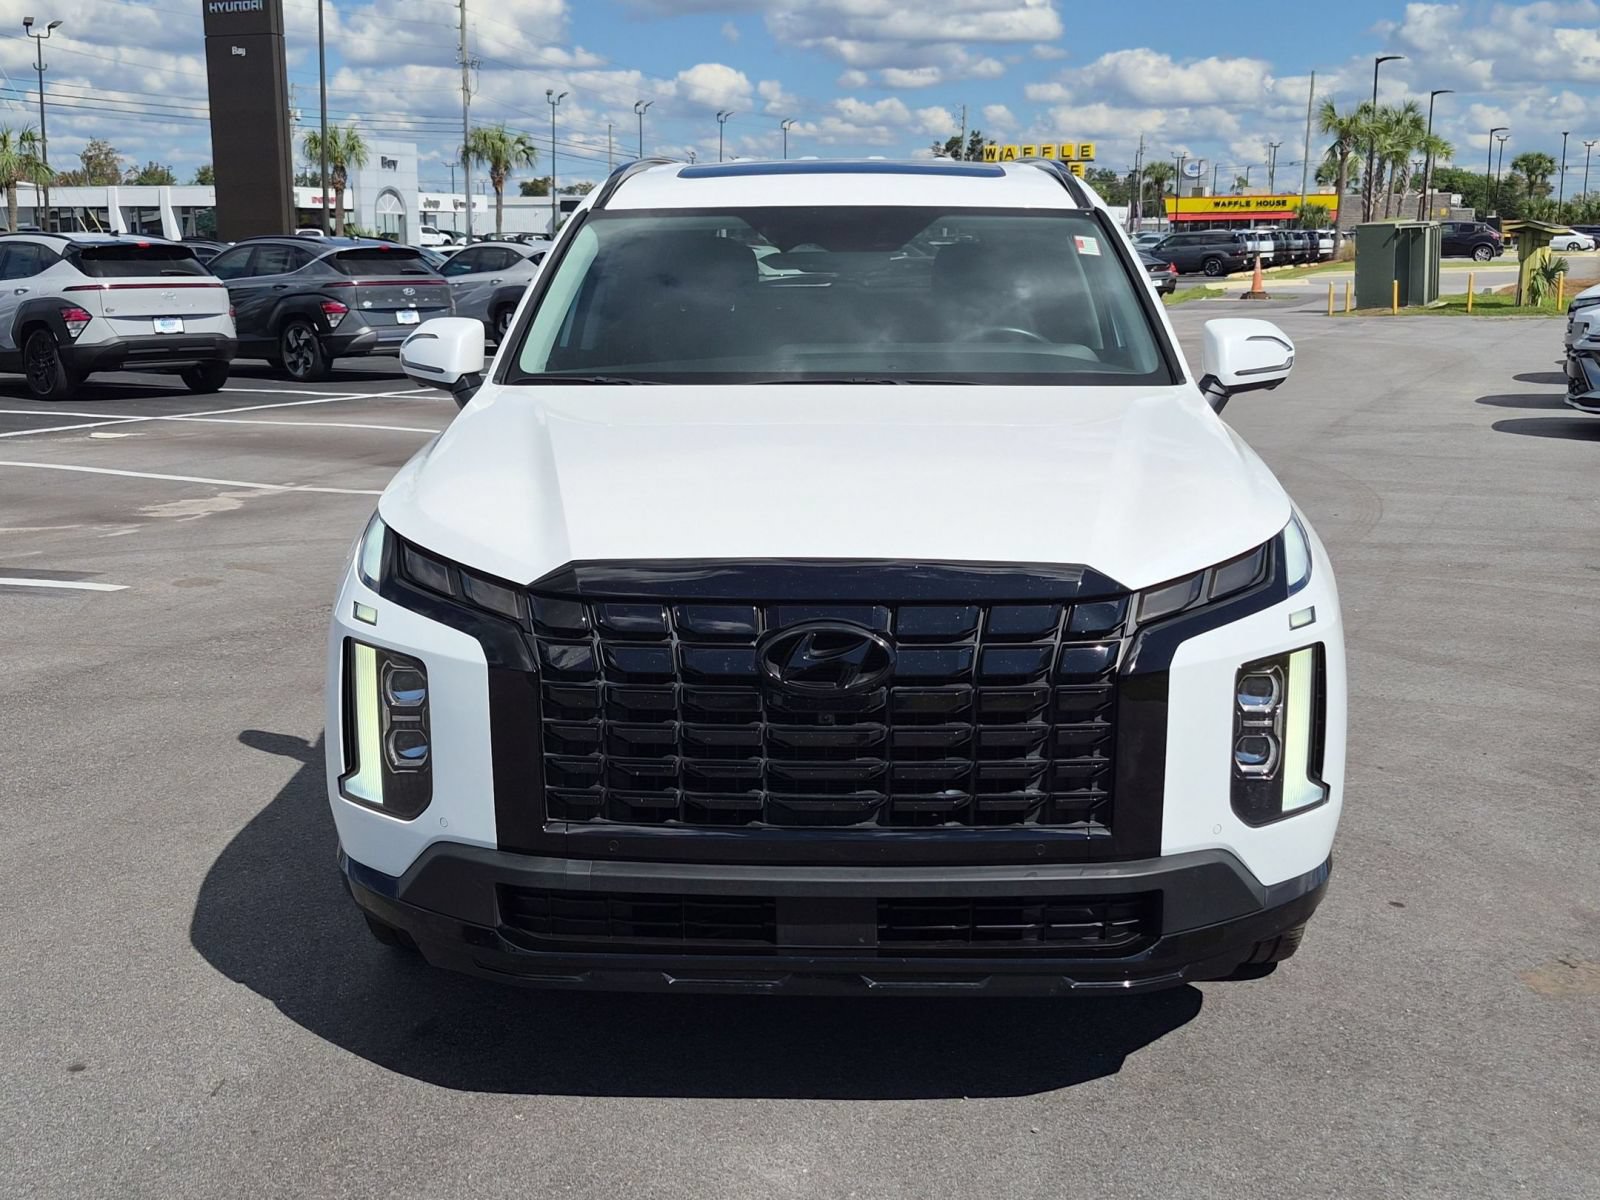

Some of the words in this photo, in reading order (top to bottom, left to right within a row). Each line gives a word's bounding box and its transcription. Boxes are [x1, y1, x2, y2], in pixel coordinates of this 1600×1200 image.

[208, 0, 264, 13] HYUNDAI
[231, 46, 246, 57] Bay
[984, 144, 1092, 161] WAFFLE
[1213, 200, 1251, 208] WAFFLE
[1256, 199, 1287, 207] HOUSE
